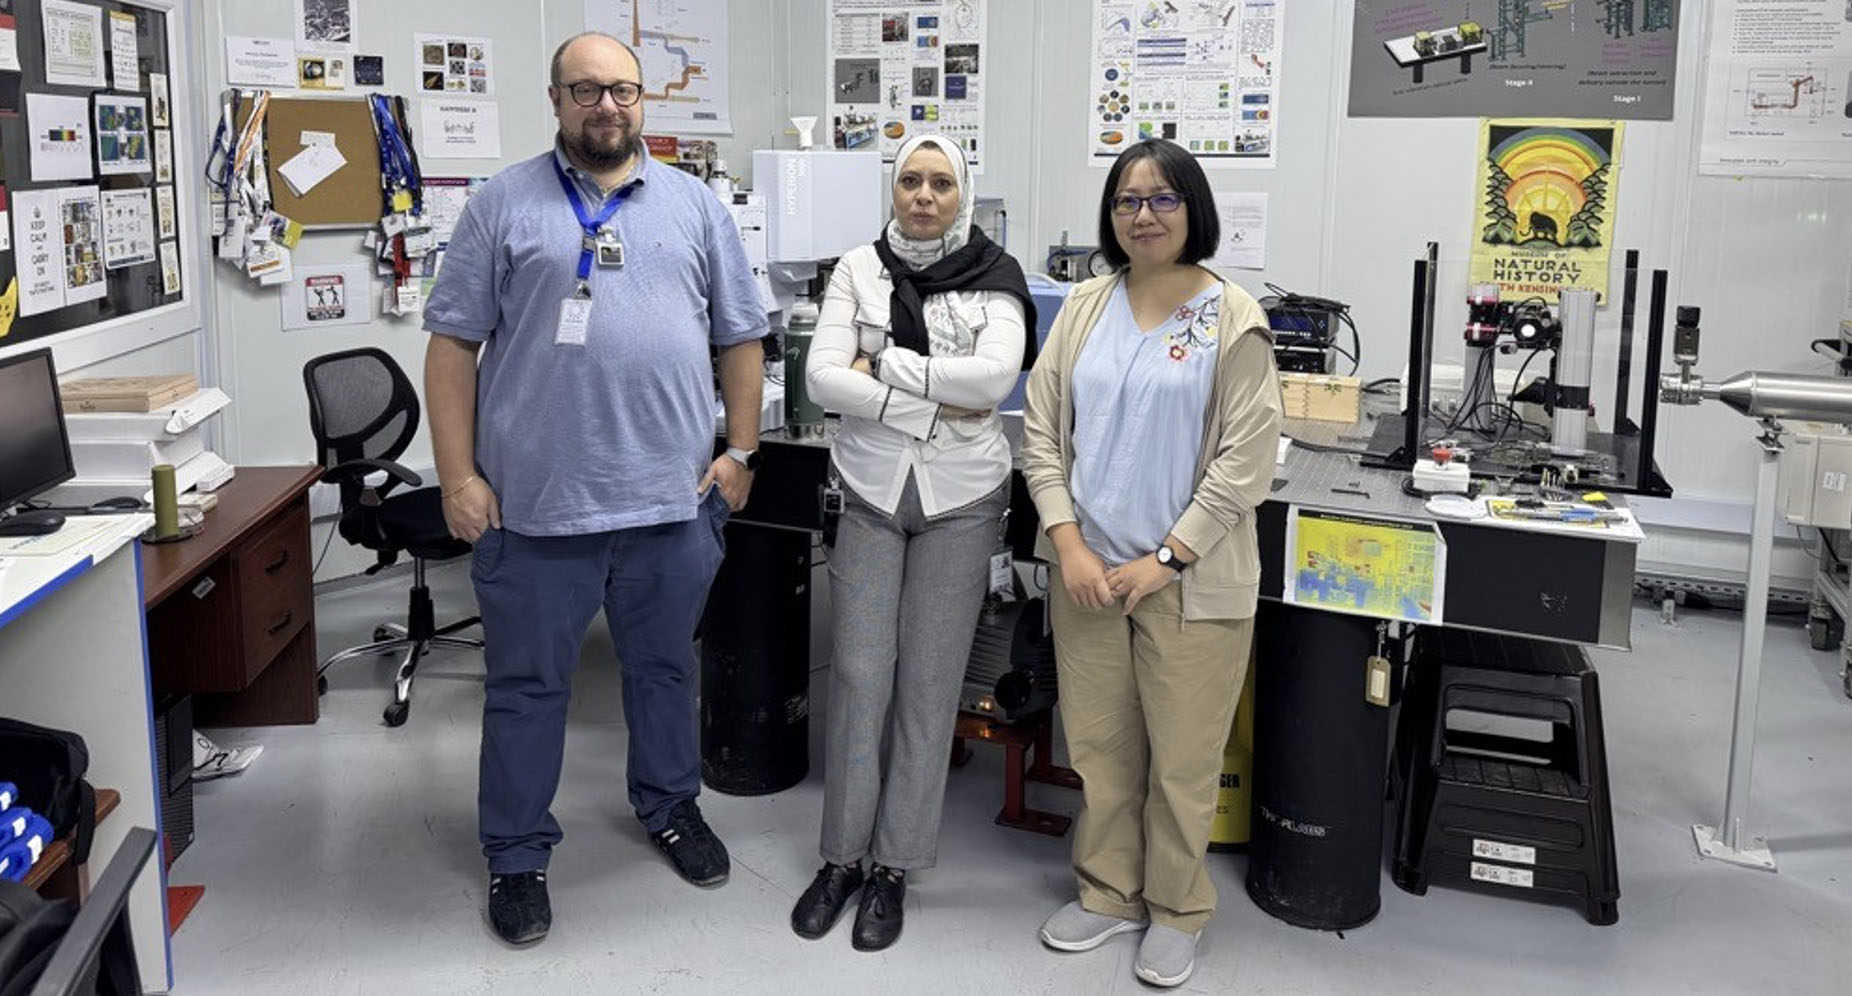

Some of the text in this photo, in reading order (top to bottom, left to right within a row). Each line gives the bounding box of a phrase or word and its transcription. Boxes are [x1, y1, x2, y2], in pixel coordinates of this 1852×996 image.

[1505, 79, 1526, 87] Stage
[1613, 95, 1636, 103] Stage
[30, 220, 45, 231] KEEP
[30, 232, 47, 243] CALM
[31, 253, 49, 265] CARRY
[1511, 250, 1548, 258] MUSEUM
[1494, 258, 1581, 272] NATURAL
[37, 266, 46, 276] ON
[1493, 270, 1580, 284] HISTORY
[1219, 773, 1240, 788] GER
